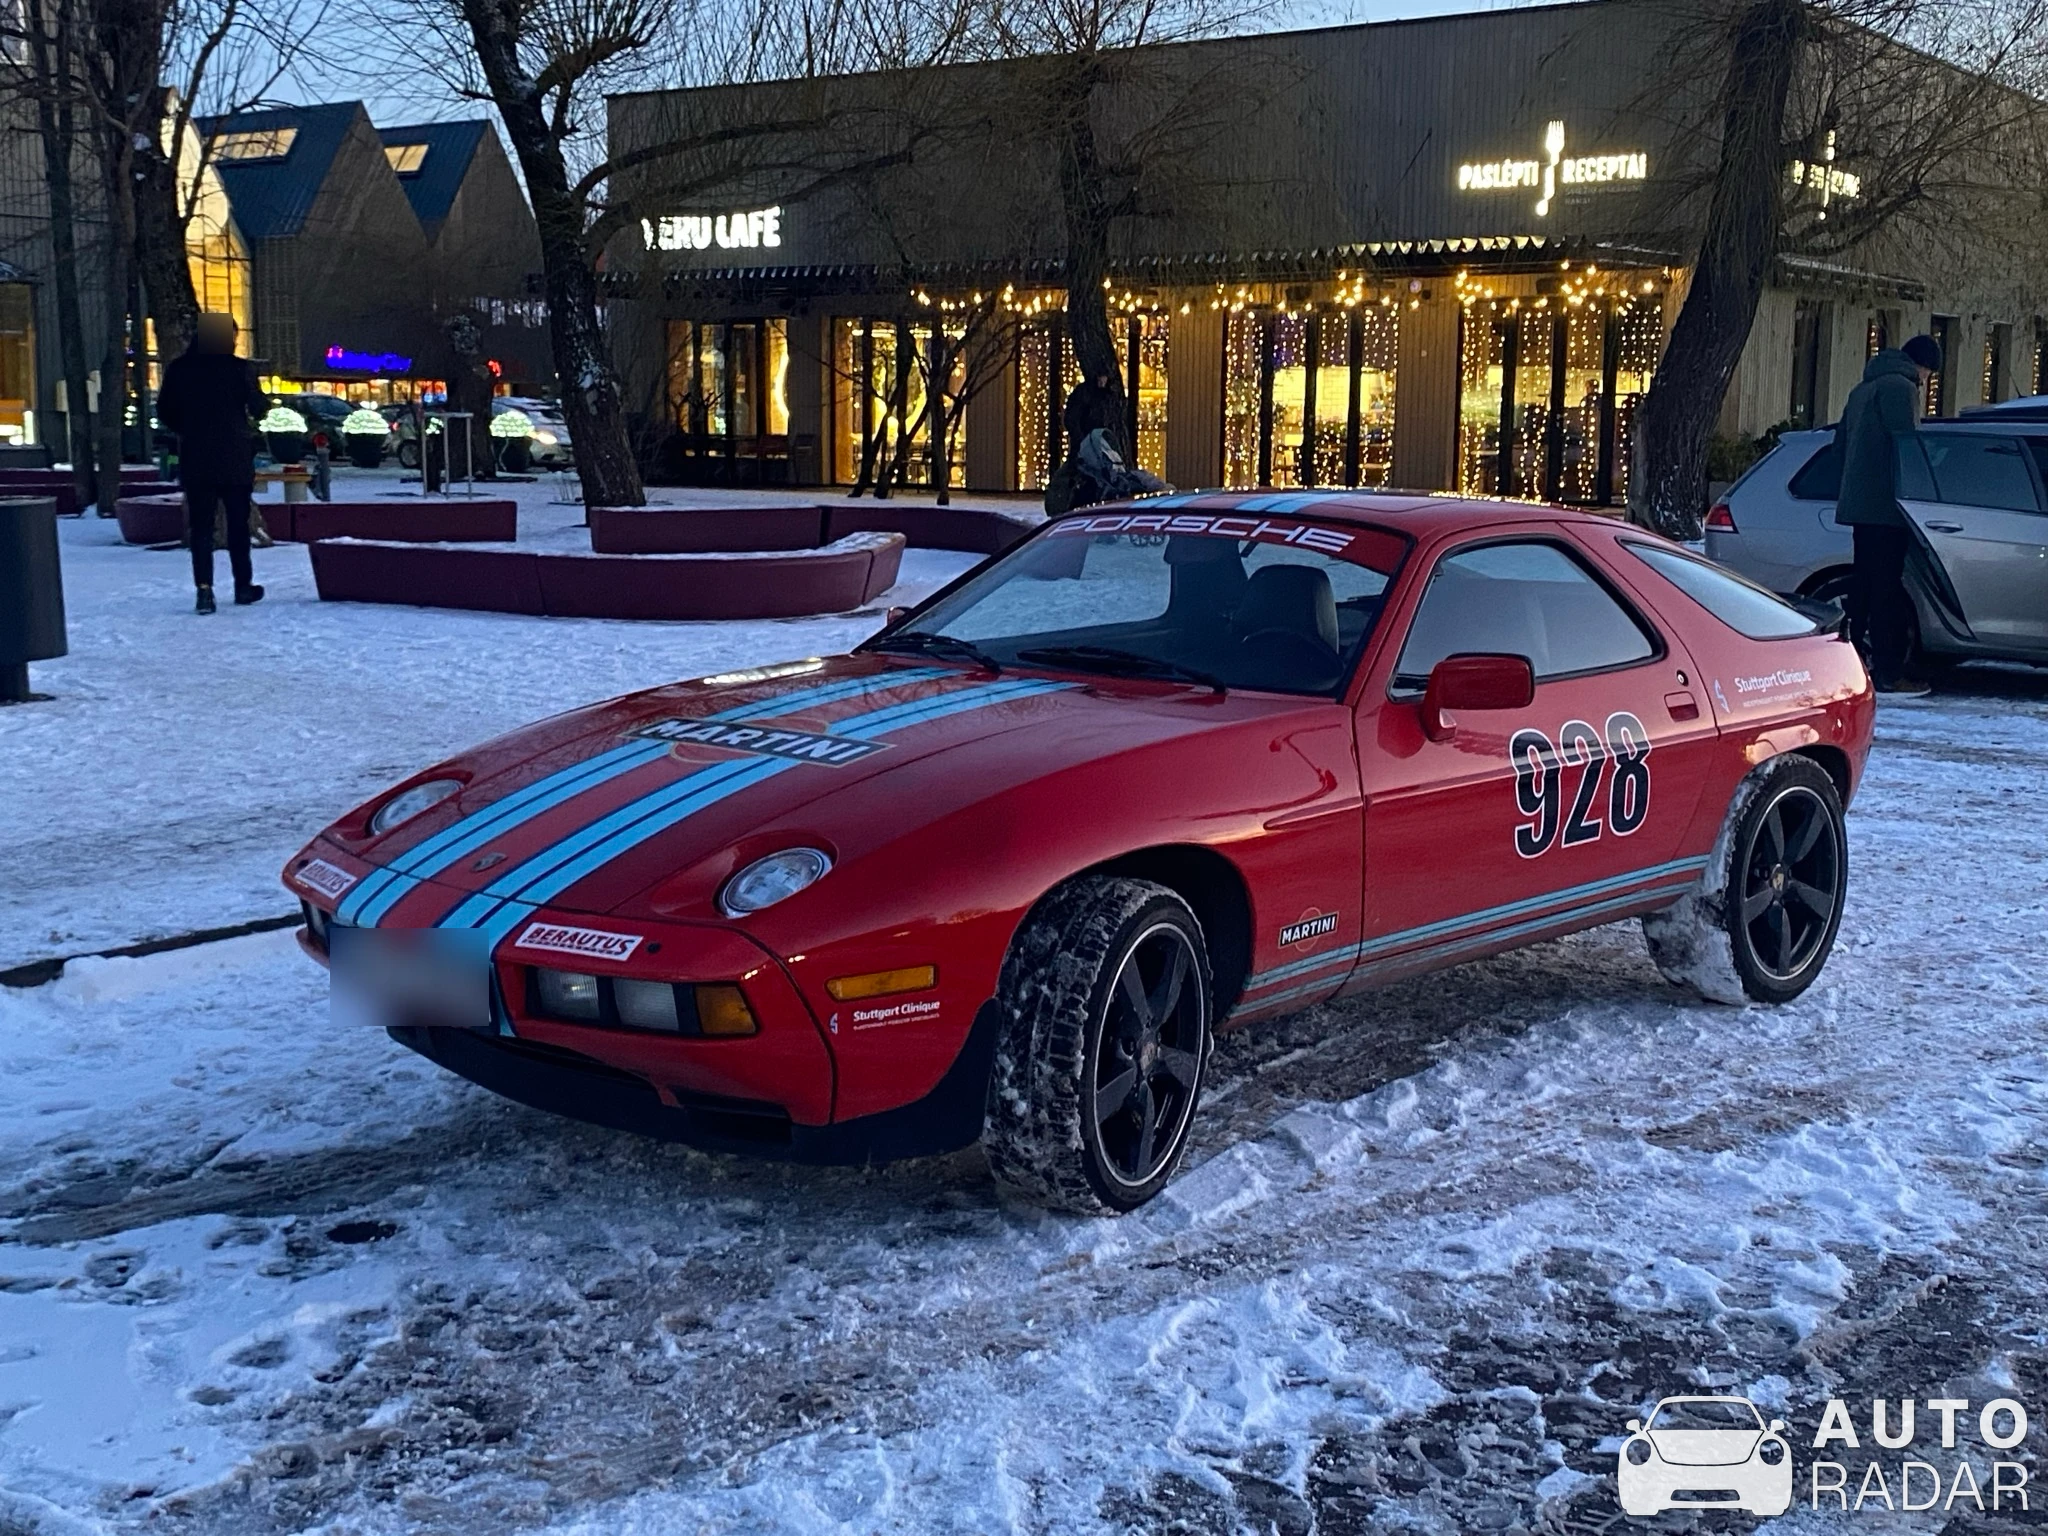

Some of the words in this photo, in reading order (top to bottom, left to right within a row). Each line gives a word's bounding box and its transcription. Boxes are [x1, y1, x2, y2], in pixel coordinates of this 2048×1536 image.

[1562, 153, 1648, 184] RECEPTAI
[1048, 515, 1355, 552] PORSCHE
[1734, 674, 1778, 693] Stuttgart
[1776, 668, 1812, 686] Clinique
[640, 720, 871, 761] MARTINI
[1509, 711, 1652, 859] 928
[301, 862, 351, 894] BERAUTUS
[526, 926, 635, 956] BERAUTUS
[1281, 916, 1336, 945] MARTINI
[853, 1006, 900, 1022] Stuttgart
[900, 1001, 940, 1015] Clinique
